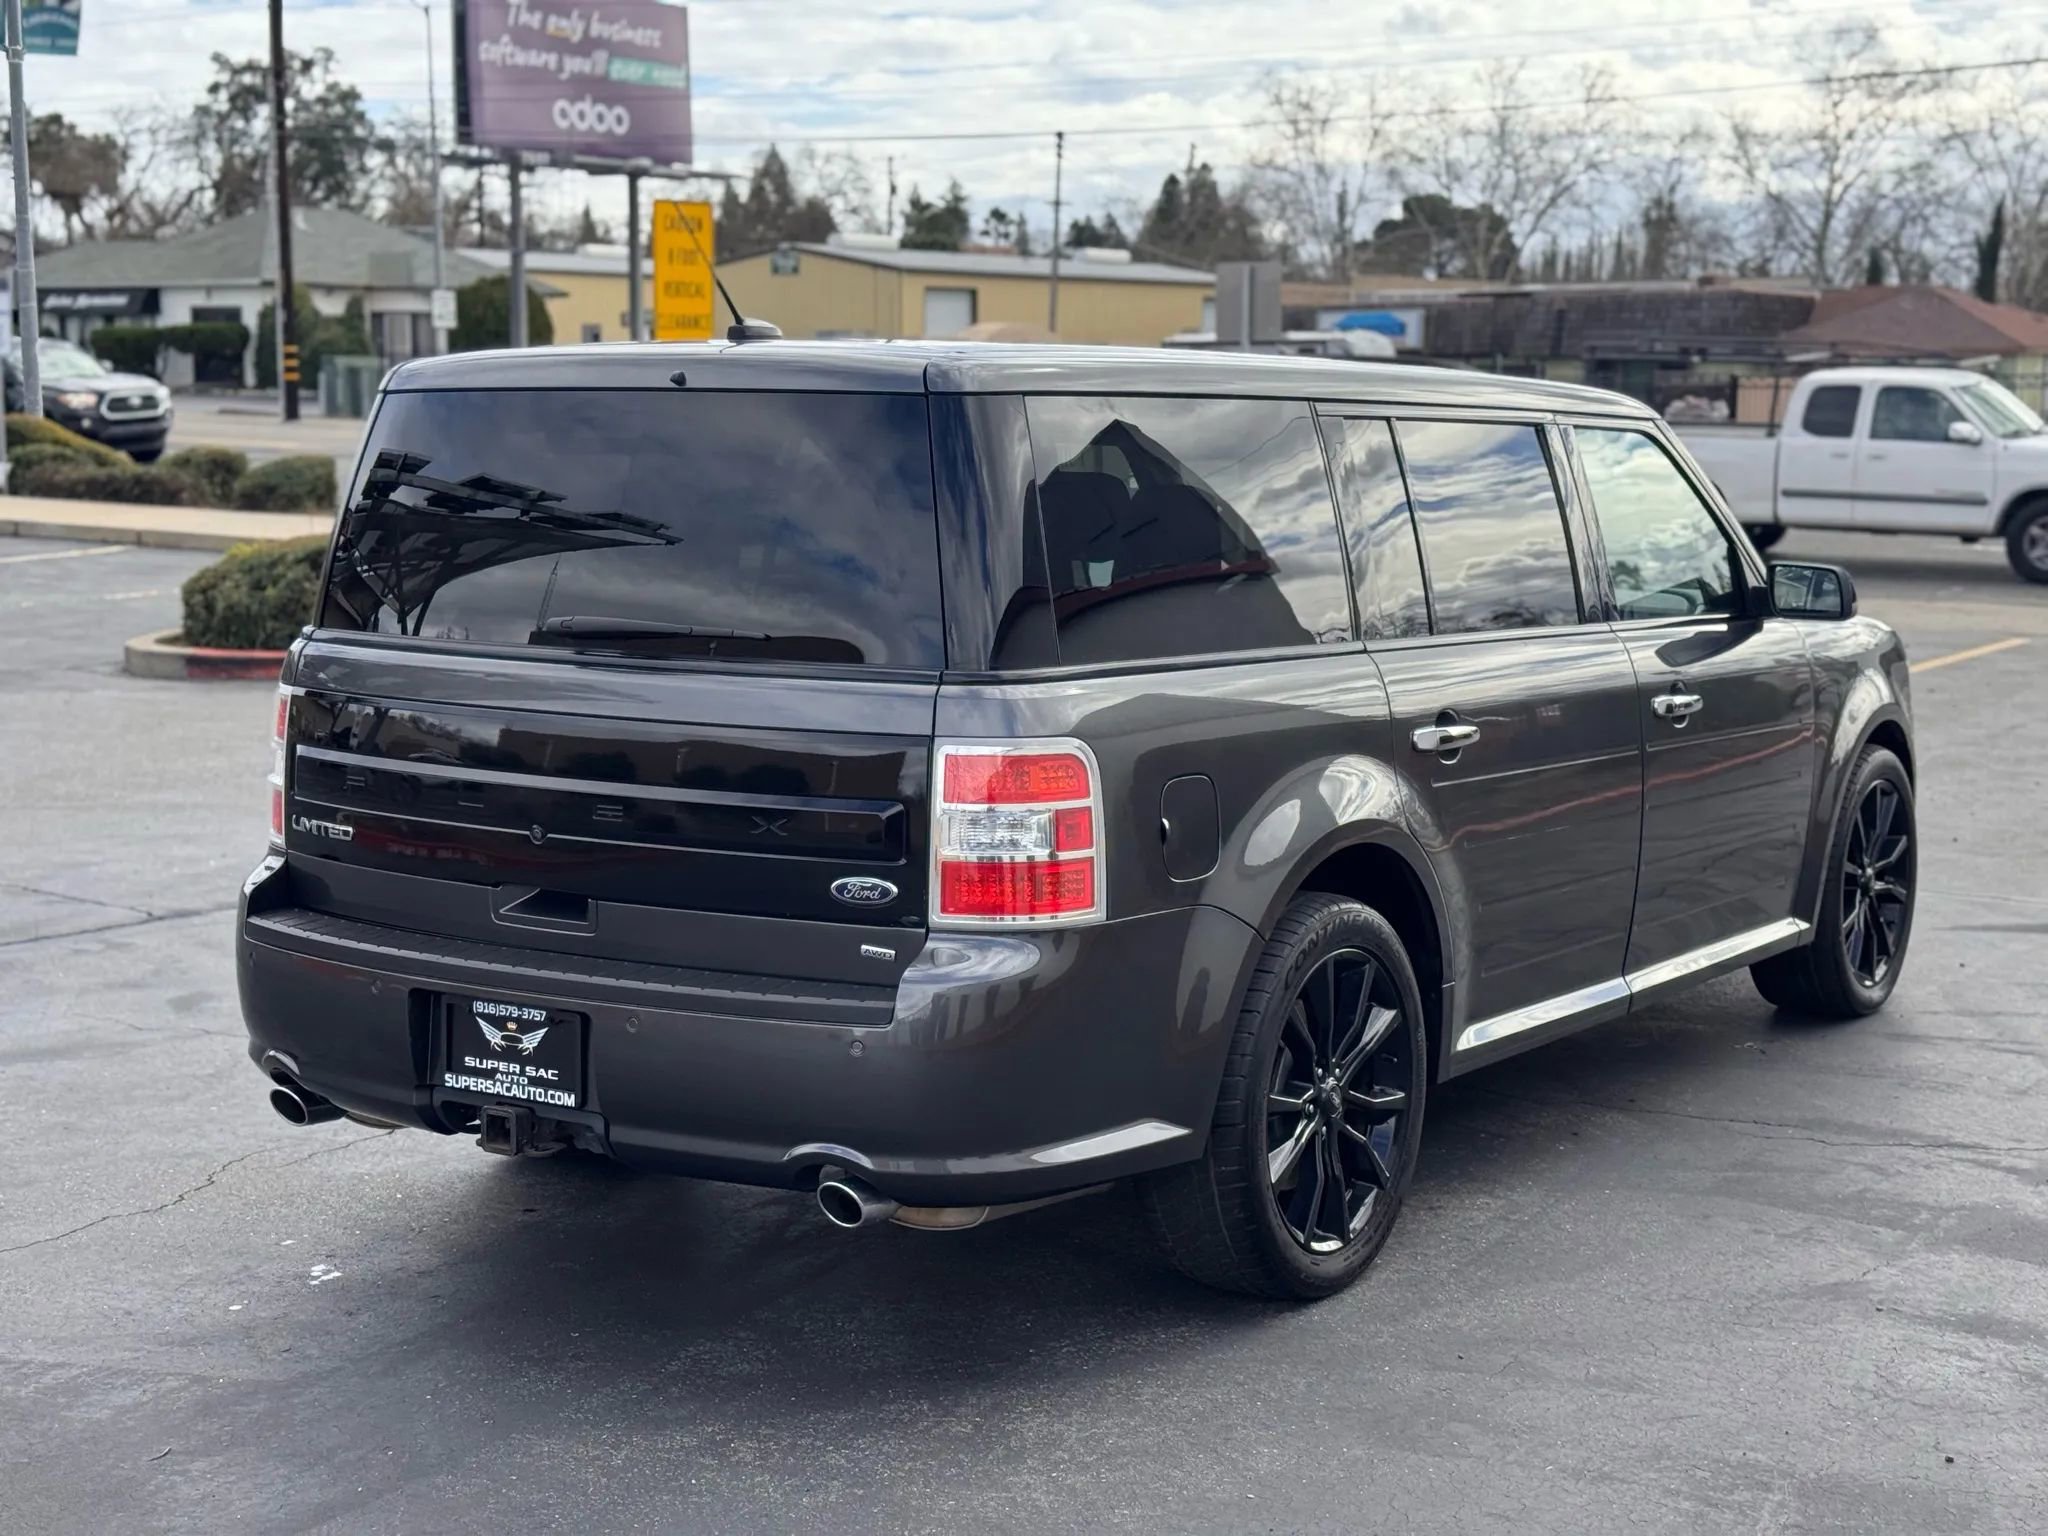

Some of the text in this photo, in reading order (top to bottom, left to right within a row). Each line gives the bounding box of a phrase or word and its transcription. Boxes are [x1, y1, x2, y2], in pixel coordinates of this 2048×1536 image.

[507, 0, 662, 48] The only business
[478, 33, 559, 72] software
[552, 94, 630, 136] odoo
[291, 814, 354, 841] LIMITED
[843, 881, 882, 900] Ford
[863, 947, 893, 960] AWD
[473, 1000, 547, 1022] (916)579-3757
[464, 1056, 559, 1081] SUPER SAC
[495, 1072, 528, 1085] AUTO
[444, 1073, 576, 1108] SUPERSACAUTO.COM
